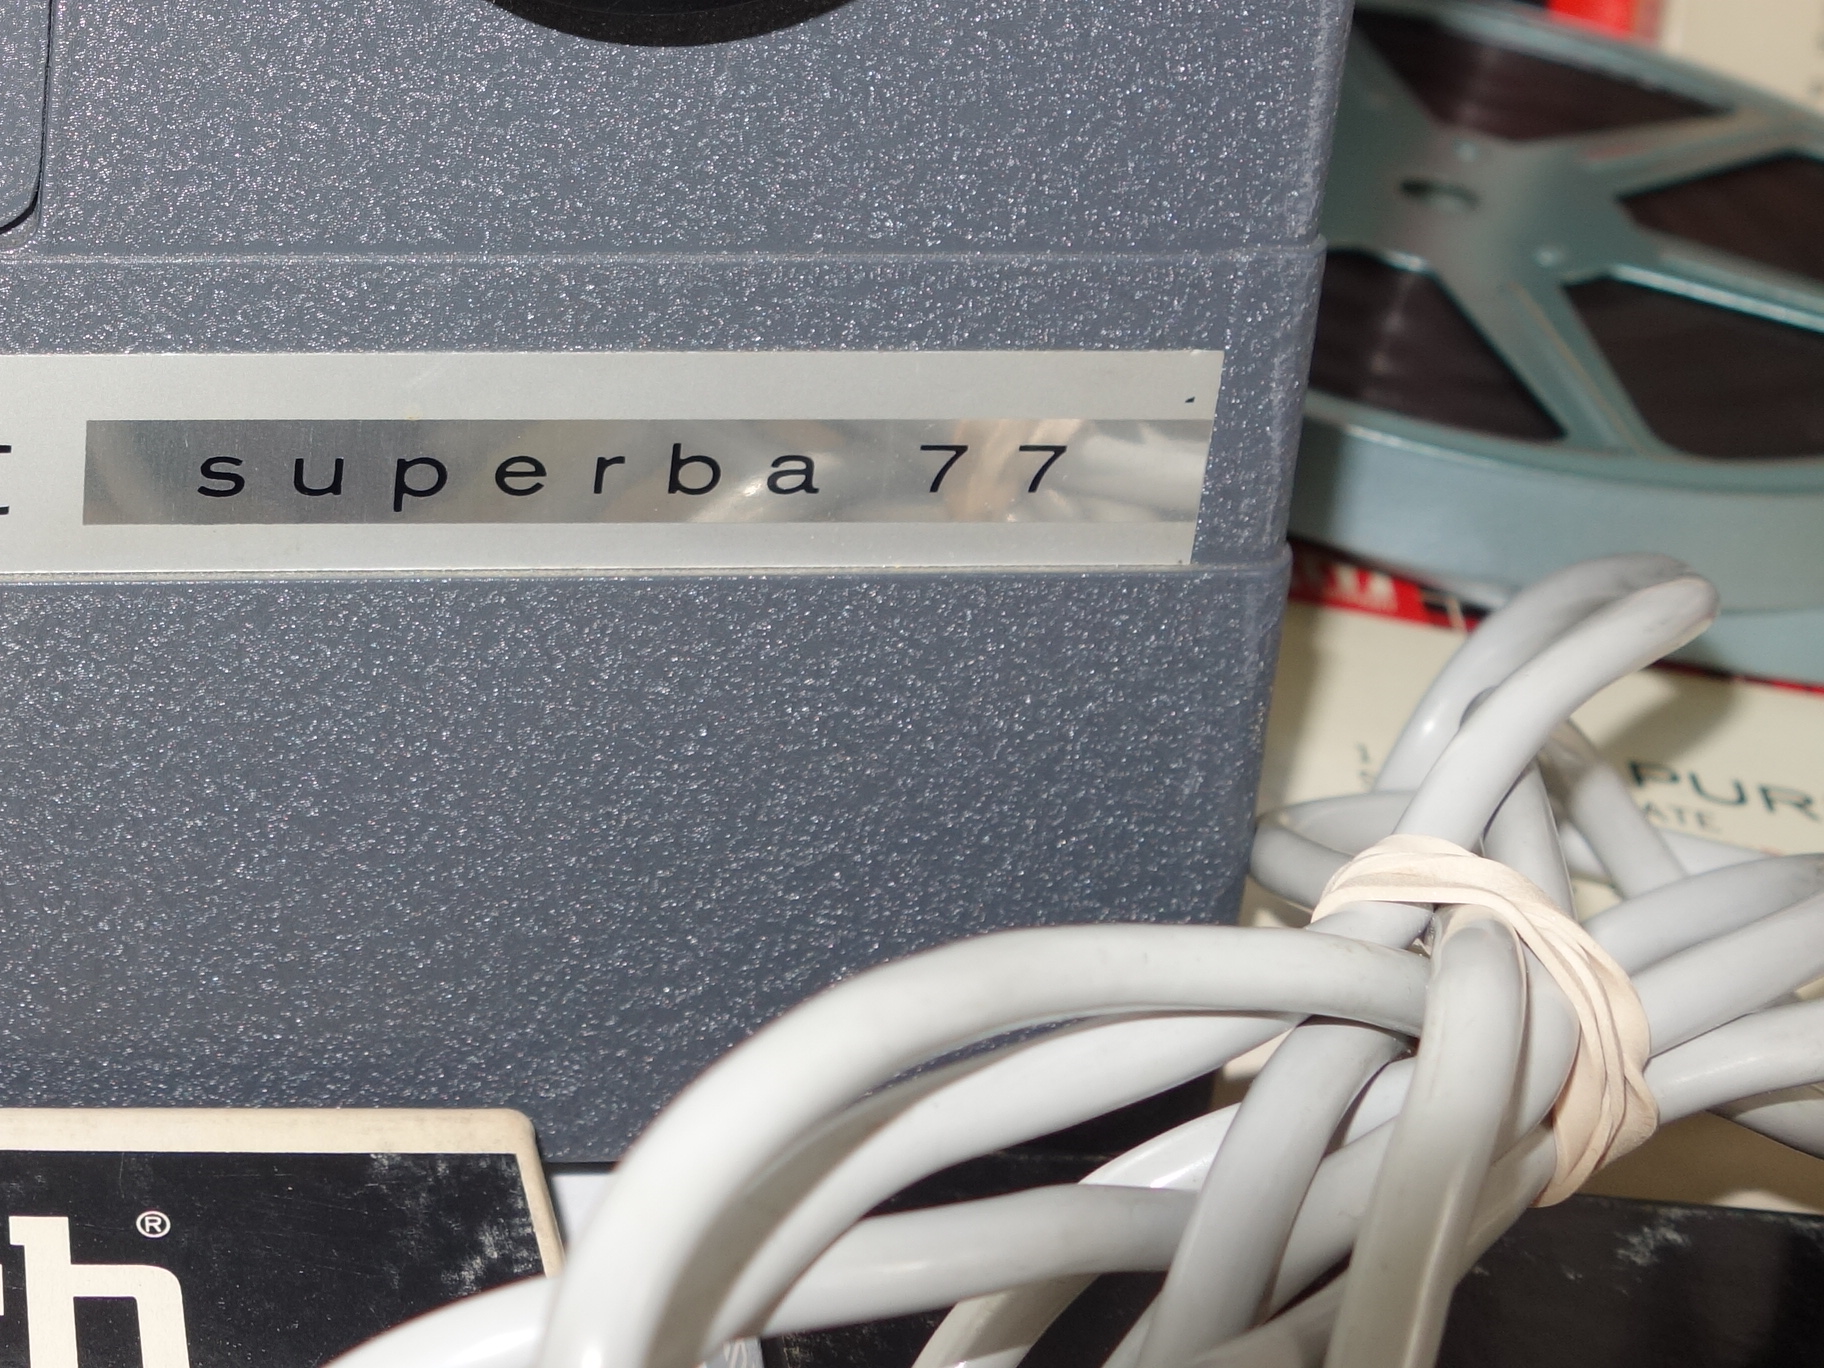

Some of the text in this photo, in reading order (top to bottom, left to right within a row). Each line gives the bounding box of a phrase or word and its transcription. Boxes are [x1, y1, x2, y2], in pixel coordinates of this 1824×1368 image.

[196, 442, 1068, 516] superba 77
[1643, 800, 1720, 832] ATE
